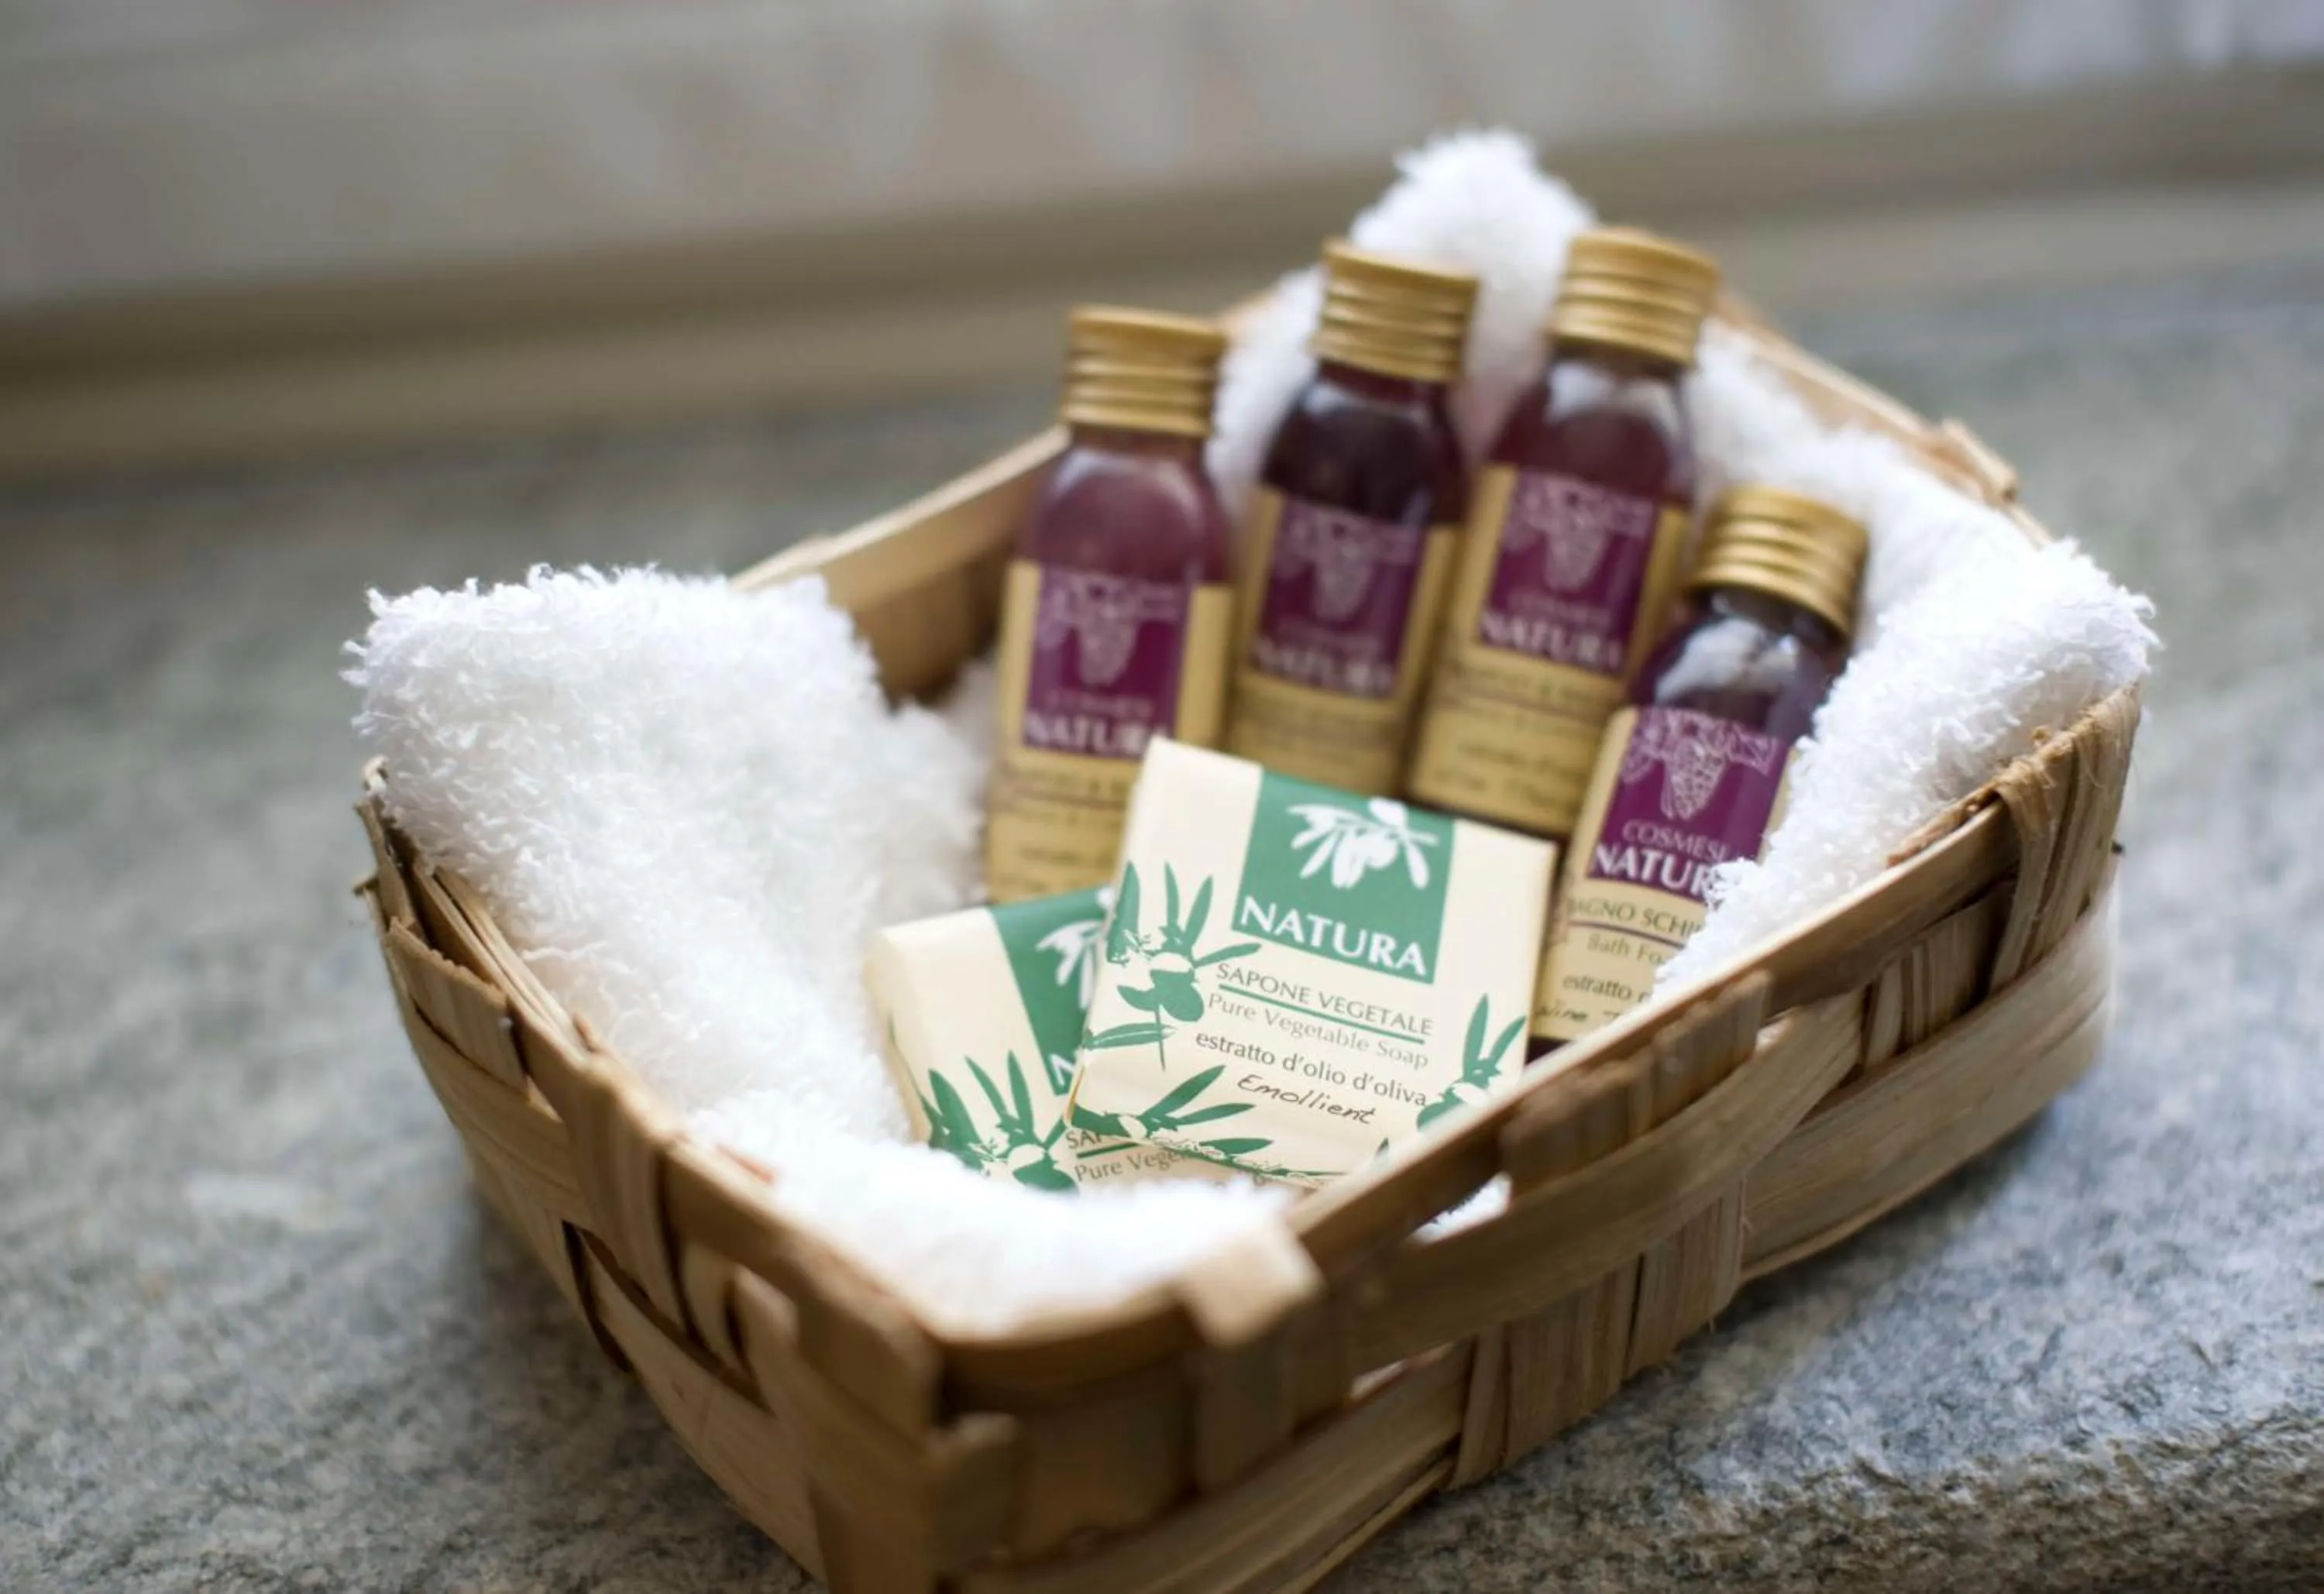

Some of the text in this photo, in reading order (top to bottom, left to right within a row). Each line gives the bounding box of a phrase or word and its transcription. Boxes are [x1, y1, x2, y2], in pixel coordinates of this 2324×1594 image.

[1592, 842, 1710, 897] NATUR
[1240, 895, 1427, 977] NATURA
[1636, 943, 1666, 965] Fo
[1208, 992, 1429, 1071] Pure Vegetable Soap
[1217, 963, 1434, 1036] SAPONE VEGETALE
[1195, 1032, 1427, 1108] estratto d'olio d'oliva
[1237, 1074, 1377, 1125] Emollient
[1074, 1161, 1124, 1183] Pure
